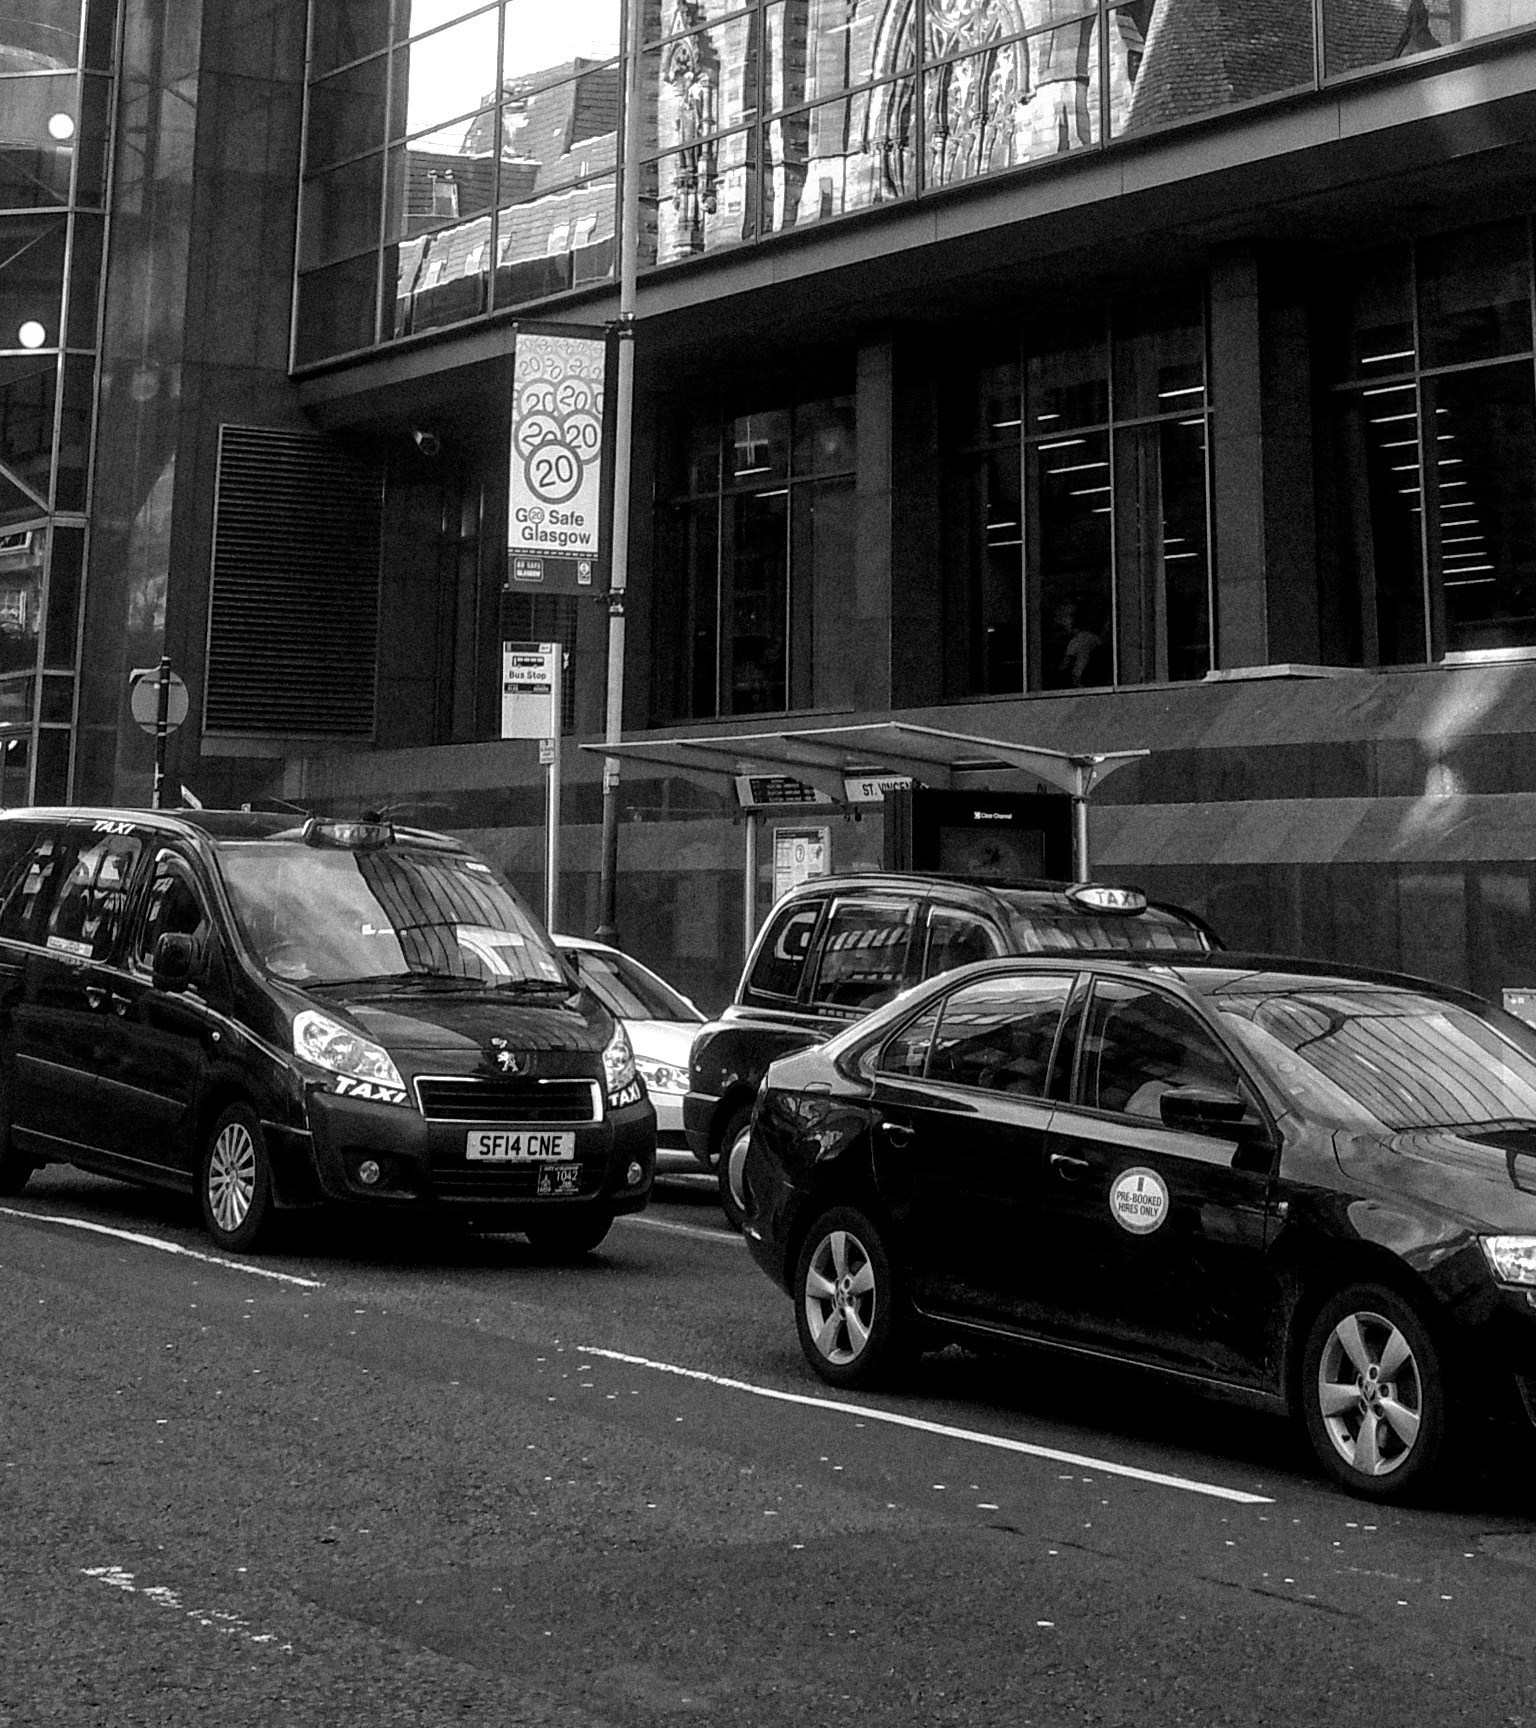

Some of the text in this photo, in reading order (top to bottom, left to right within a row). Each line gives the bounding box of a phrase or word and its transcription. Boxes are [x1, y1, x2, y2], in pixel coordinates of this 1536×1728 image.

[519, 357, 540, 376] 20
[526, 392, 556, 413] 20
[559, 385, 588, 411] 20
[566, 423, 598, 448] 20
[536, 455, 574, 488] 20
[548, 509, 585, 527] Safe
[521, 525, 592, 547] Glasgow
[508, 670, 547, 681] Bus Stop
[862, 783, 879, 797] ST.
[92, 820, 136, 835] TAXI
[335, 1074, 408, 1104] TAXI
[608, 1080, 641, 1108] TAXI
[479, 1135, 563, 1156] SF14 CNE
[556, 1170, 578, 1182] 1042
[1116, 1191, 1162, 1207] PRE-BOOKED
[1118, 1202, 1159, 1217] HIRES ONLY
